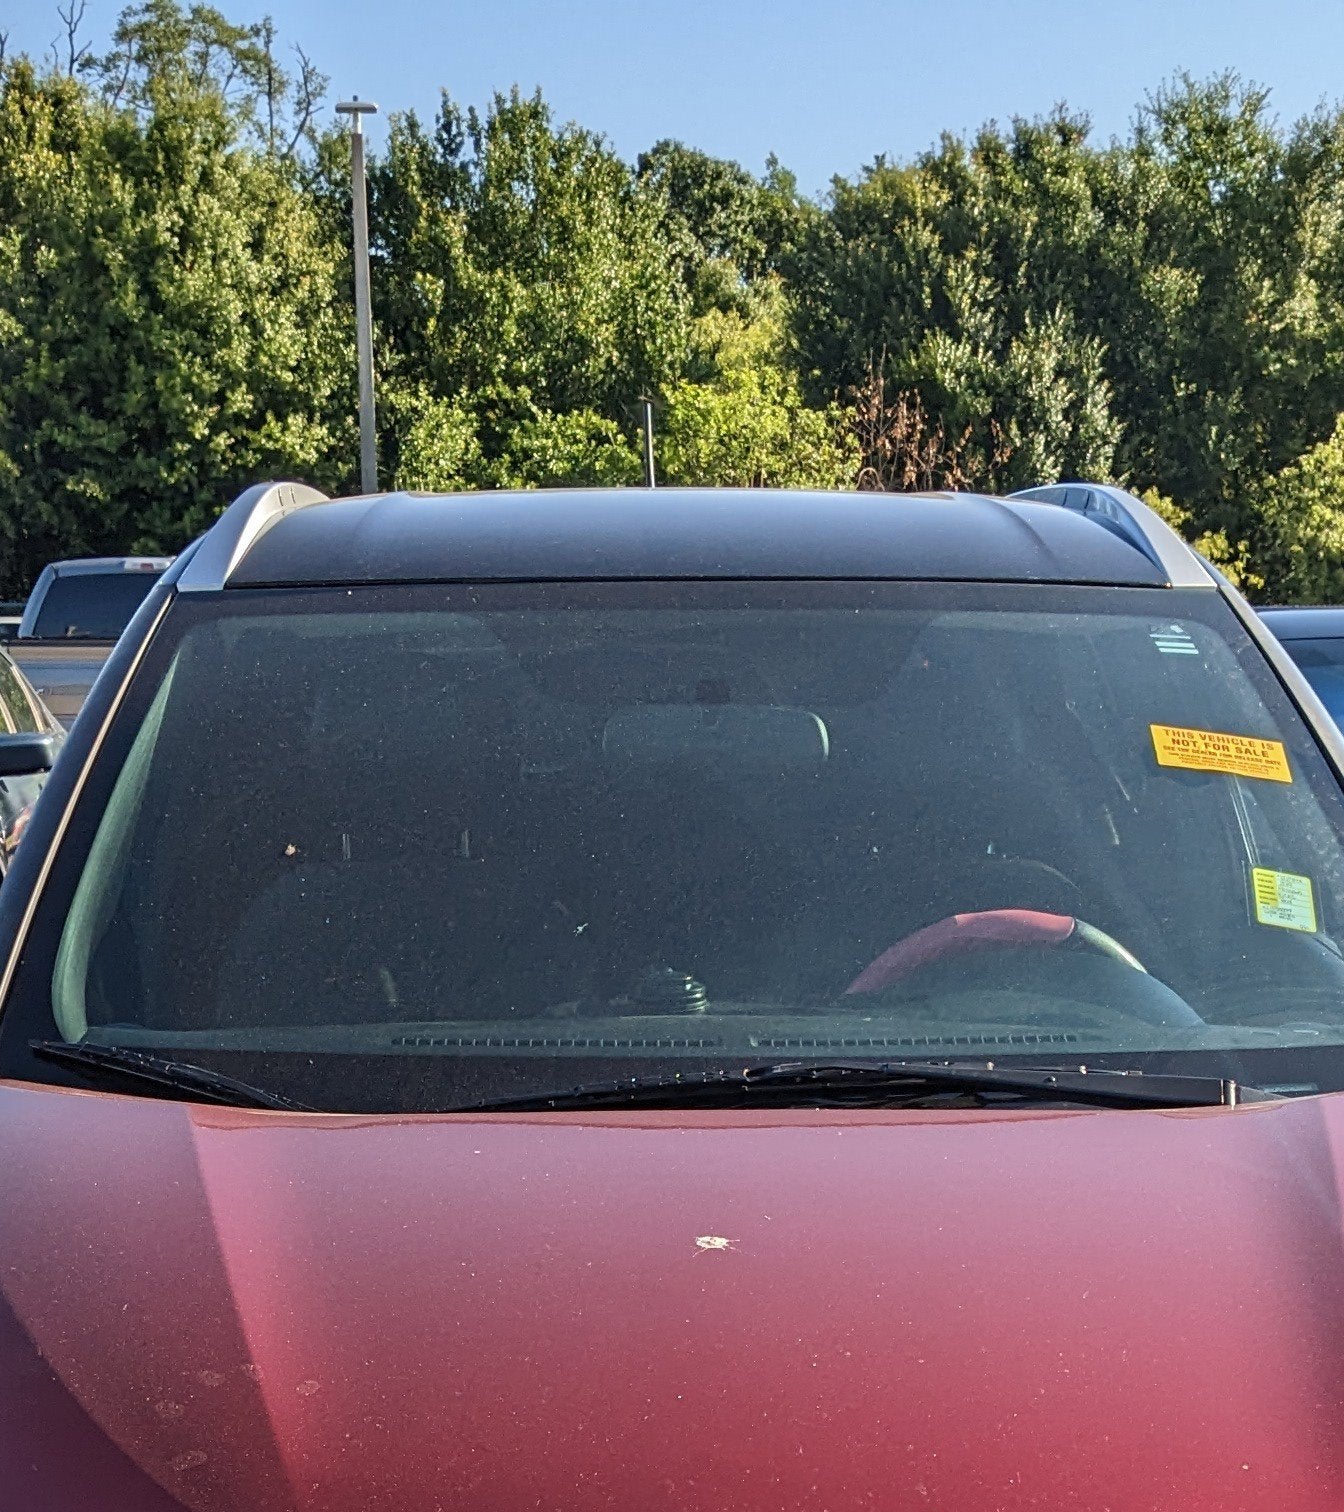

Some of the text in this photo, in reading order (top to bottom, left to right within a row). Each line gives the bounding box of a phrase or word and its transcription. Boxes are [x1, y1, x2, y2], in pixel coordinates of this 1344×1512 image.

[1163, 729, 1275, 751] THIS VEHICLE IS
[1171, 738, 1269, 758] NOT FOR SALE
